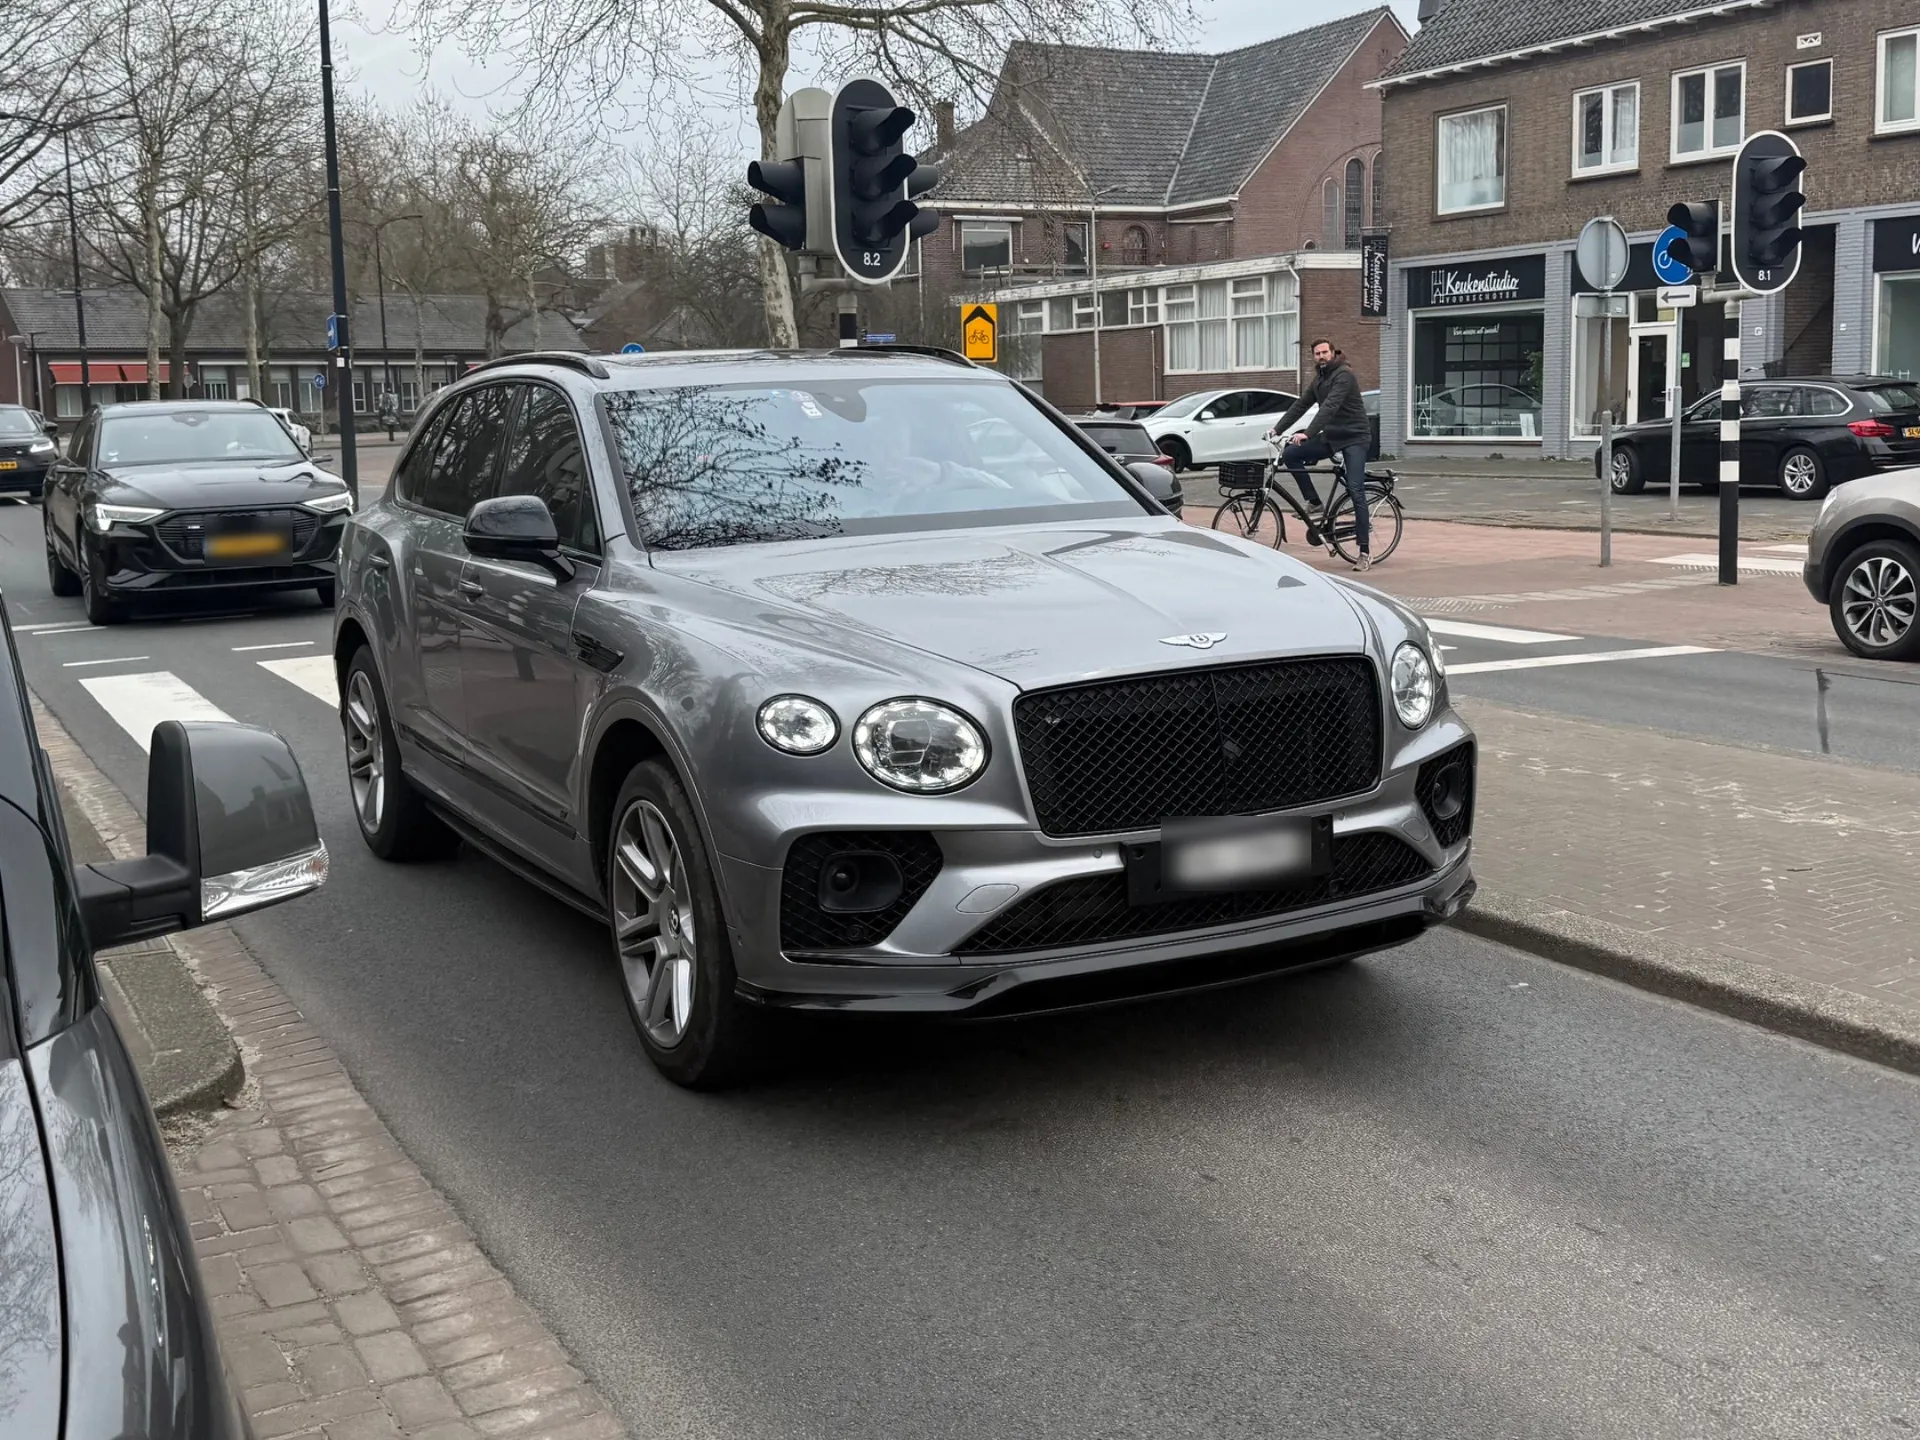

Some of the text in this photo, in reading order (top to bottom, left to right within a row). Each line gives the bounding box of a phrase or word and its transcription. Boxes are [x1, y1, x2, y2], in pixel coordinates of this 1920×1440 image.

[863, 251, 881, 266] 8.2
[1373, 252, 1386, 312] Keukenstudio
[1445, 270, 1520, 295] Keukenstudio
[1758, 269, 1771, 281] 8.1
